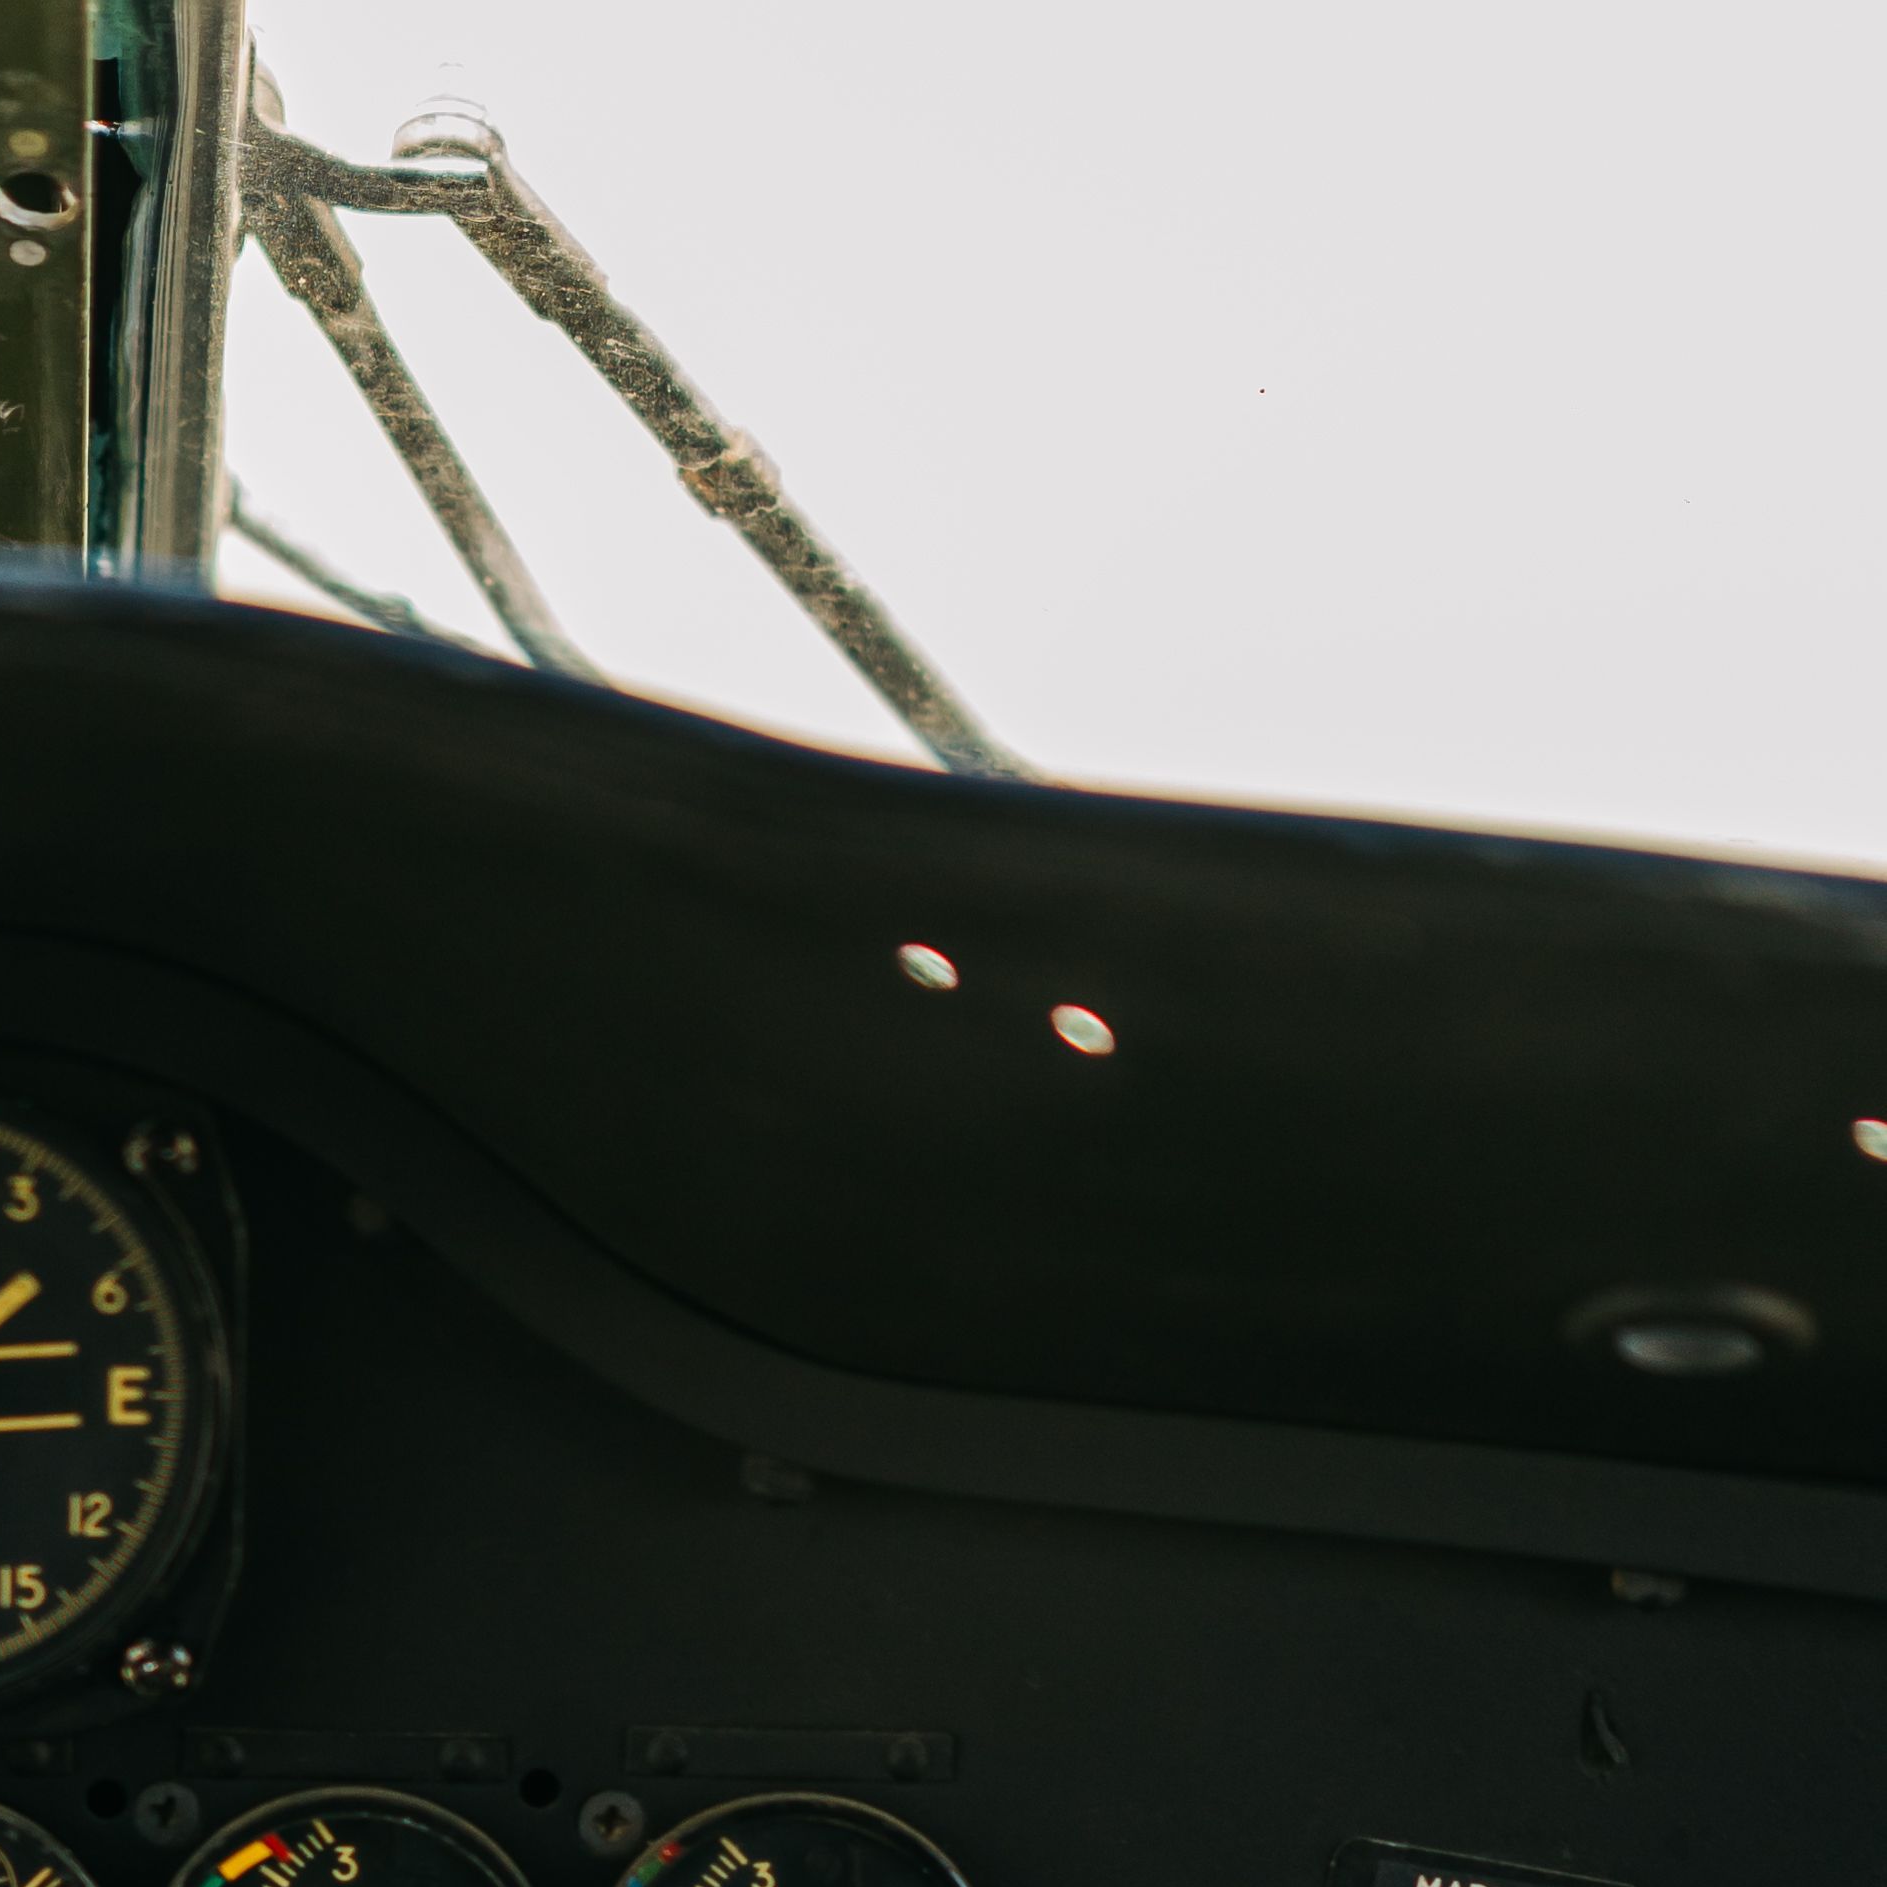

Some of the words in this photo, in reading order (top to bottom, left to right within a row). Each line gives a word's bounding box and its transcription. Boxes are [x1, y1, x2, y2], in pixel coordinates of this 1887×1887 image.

[5, 1175, 38, 1221] 3
[108, 1366, 151, 1426] E
[0, 1564, 46, 1609] 15
[332, 1845, 359, 1882] 3
